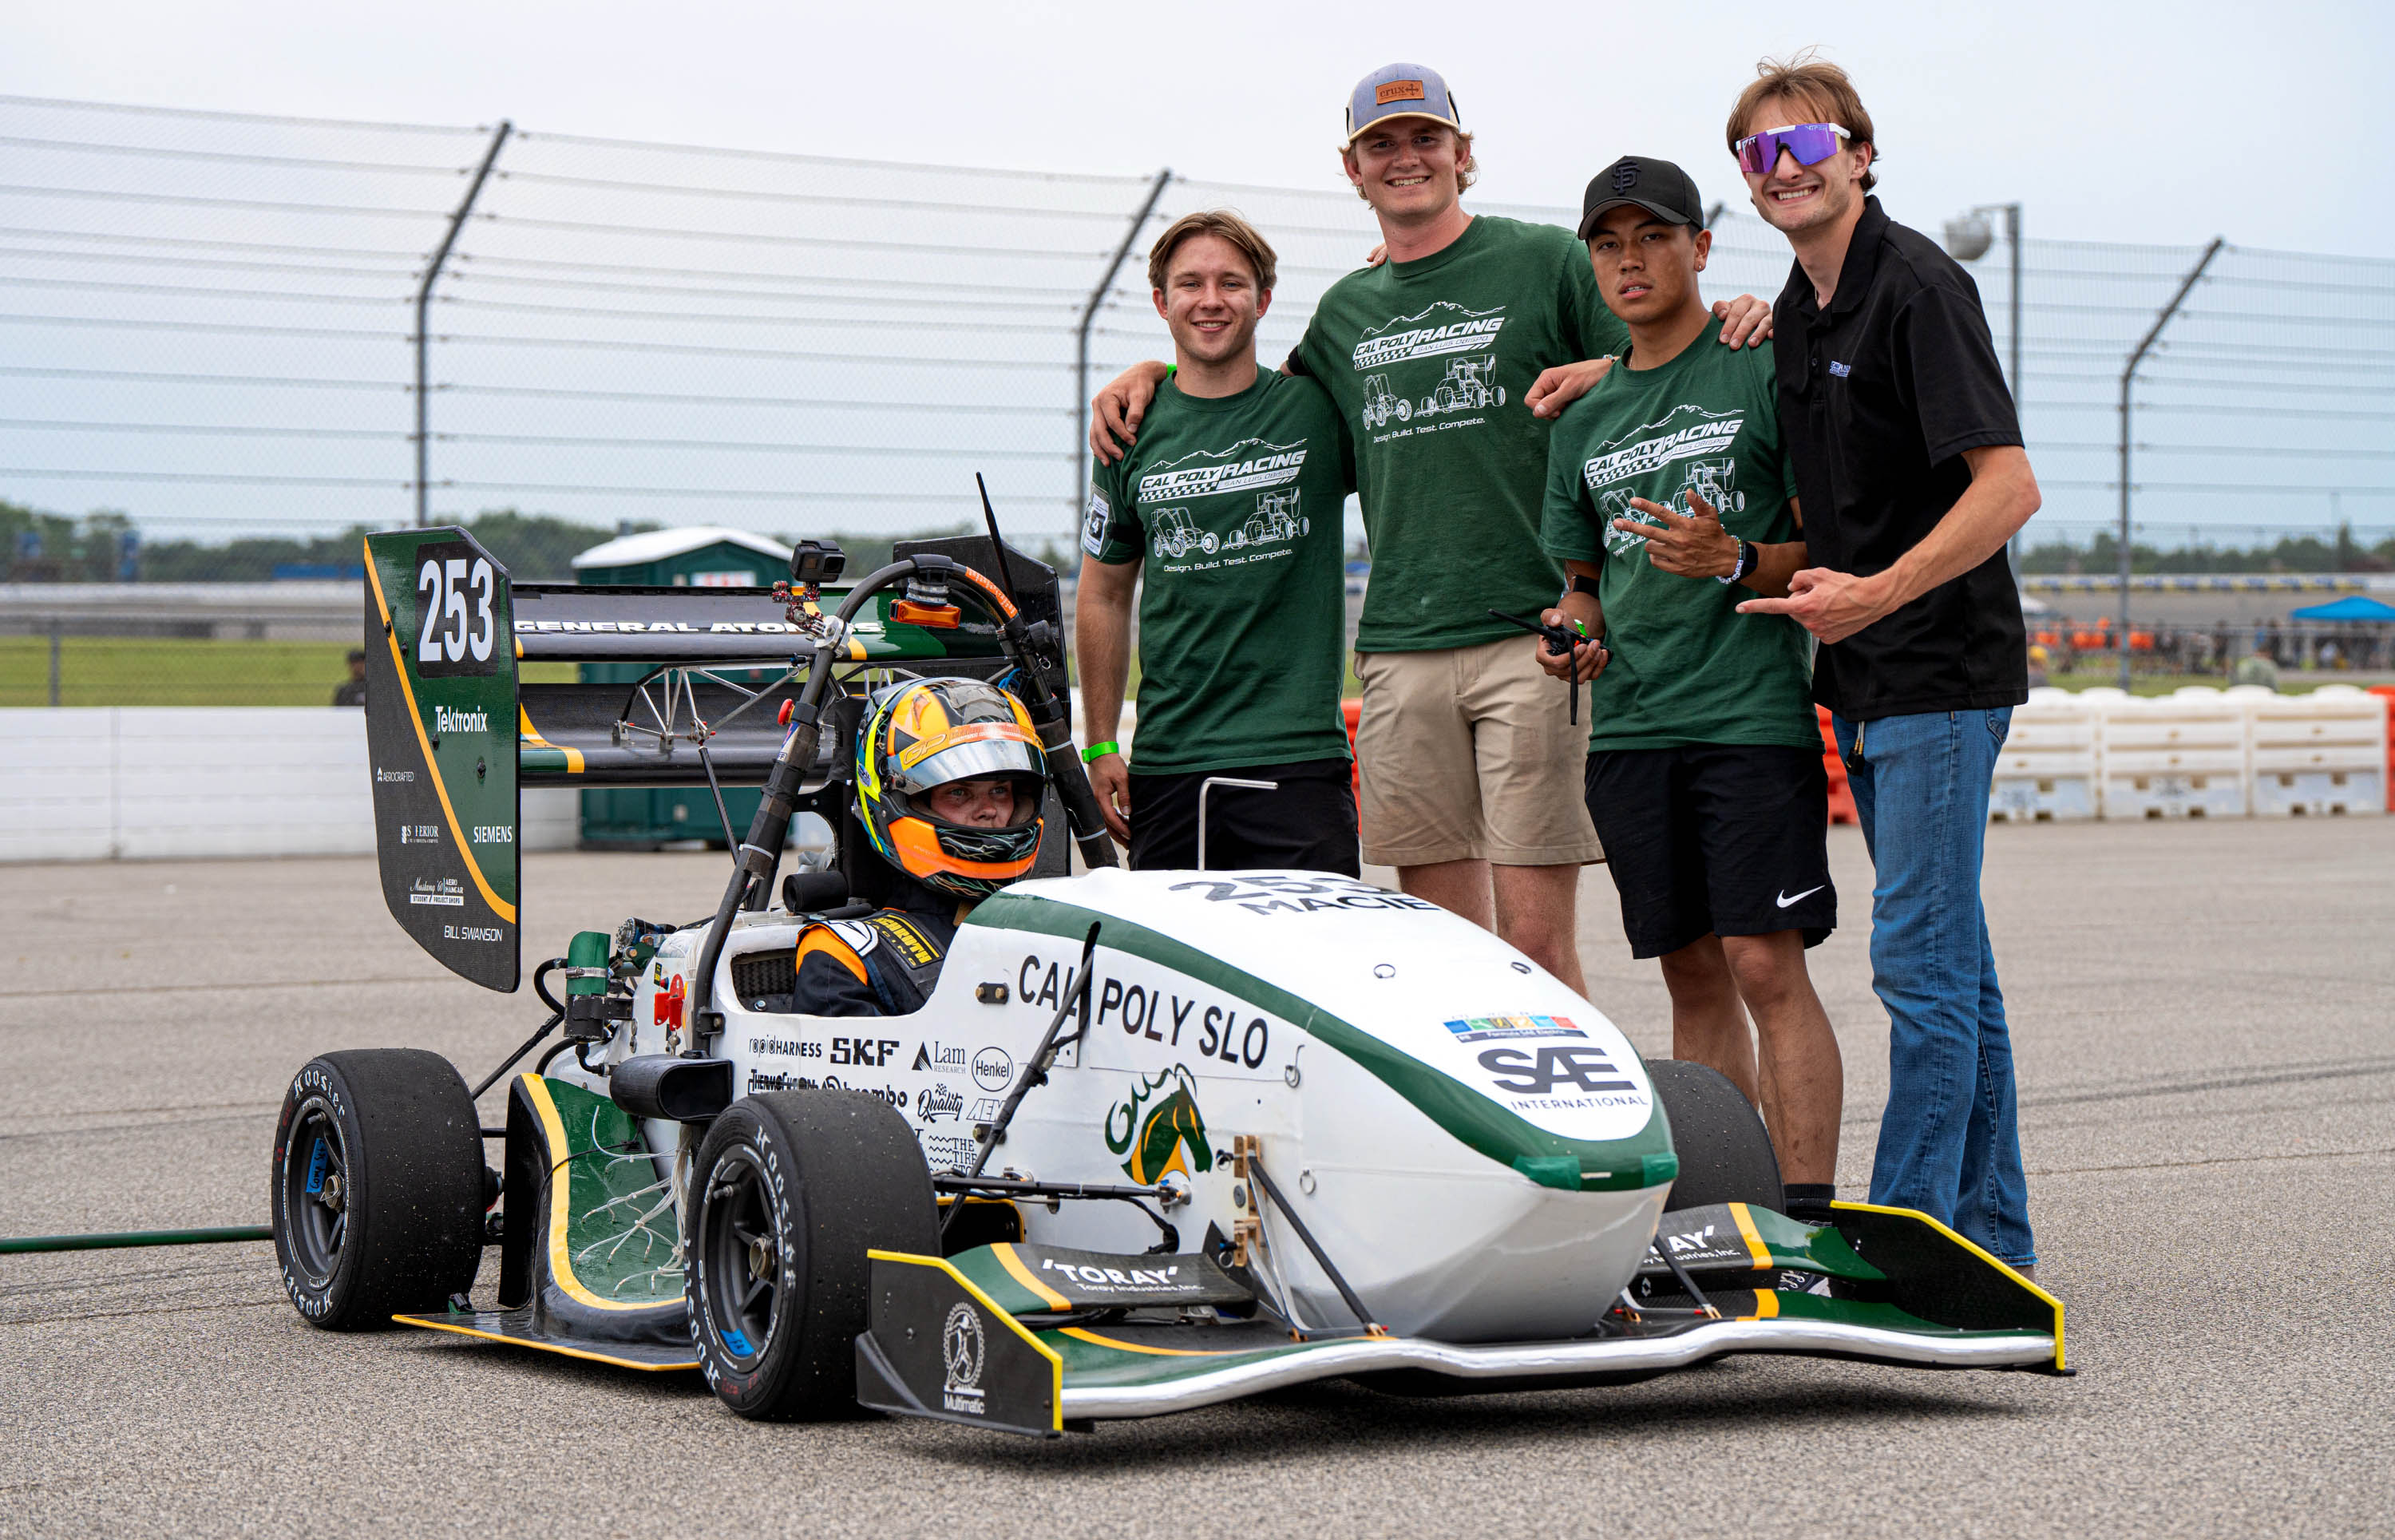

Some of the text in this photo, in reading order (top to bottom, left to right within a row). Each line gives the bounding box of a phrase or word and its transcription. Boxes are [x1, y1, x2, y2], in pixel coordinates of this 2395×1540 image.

[1355, 317, 1505, 358] CAL POLY RACING
[1586, 419, 1744, 475] CAL POLY RACING
[1141, 449, 1308, 489] CAL POLY RACING
[418, 557, 493, 663] 253
[514, 620, 699, 632] GENERAL
[435, 705, 488, 732] Tektronix
[383, 771, 414, 782] AEROCRAFTED
[407, 825, 439, 837] SPERIOR
[473, 825, 513, 843] SIEMENS
[410, 877, 436, 894] Mustang
[1168, 875, 1403, 902] 253
[444, 925, 503, 942] BILL SWANSON
[1019, 955, 1269, 1069] CAL POLY SLO
[749, 1034, 822, 1058] rapidHARNESS
[829, 1037, 900, 1067] SKF
[934, 1040, 965, 1064] Lam
[933, 1065, 966, 1075] RESEARCH
[976, 1059, 1009, 1078] Henkel
[1478, 1047, 1637, 1094] SAE
[917, 1088, 964, 1123] Quality
[1510, 1095, 1649, 1110] INTERNATIONAL
[952, 1138, 975, 1152] THE
[944, 1393, 985, 1415] Multimatic
